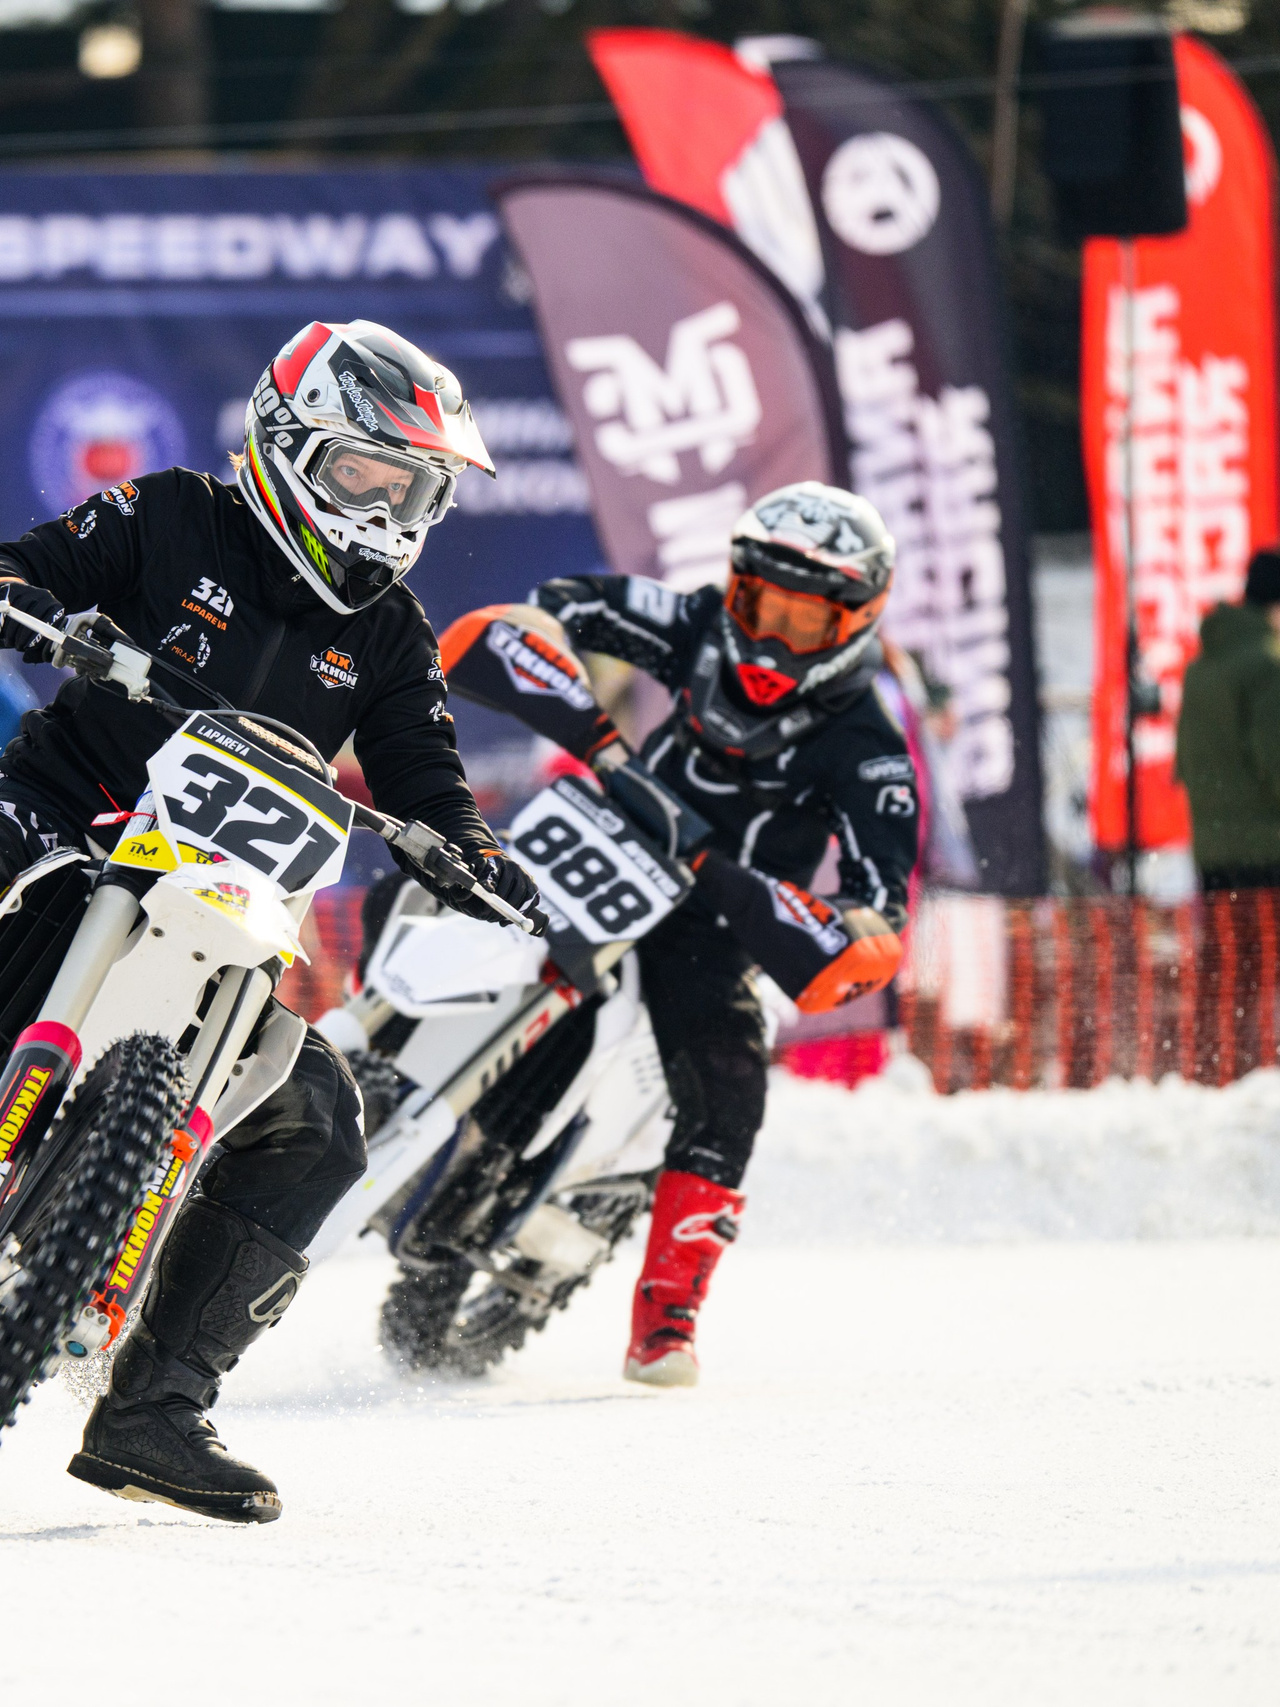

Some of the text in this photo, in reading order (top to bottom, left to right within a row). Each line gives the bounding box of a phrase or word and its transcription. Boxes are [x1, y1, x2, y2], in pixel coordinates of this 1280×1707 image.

[181, 598, 228, 631] LAPAREVA
[191, 576, 235, 617] 321
[171, 645, 196, 664] MRAZI
[311, 657, 358, 687] TKHON
[196, 724, 251, 758] LAPAREVA
[164, 752, 341, 894] 321
[514, 814, 653, 935] 888
[160, 1156, 185, 1198] TEAM
[109, 1189, 164, 1290] TIKHON
